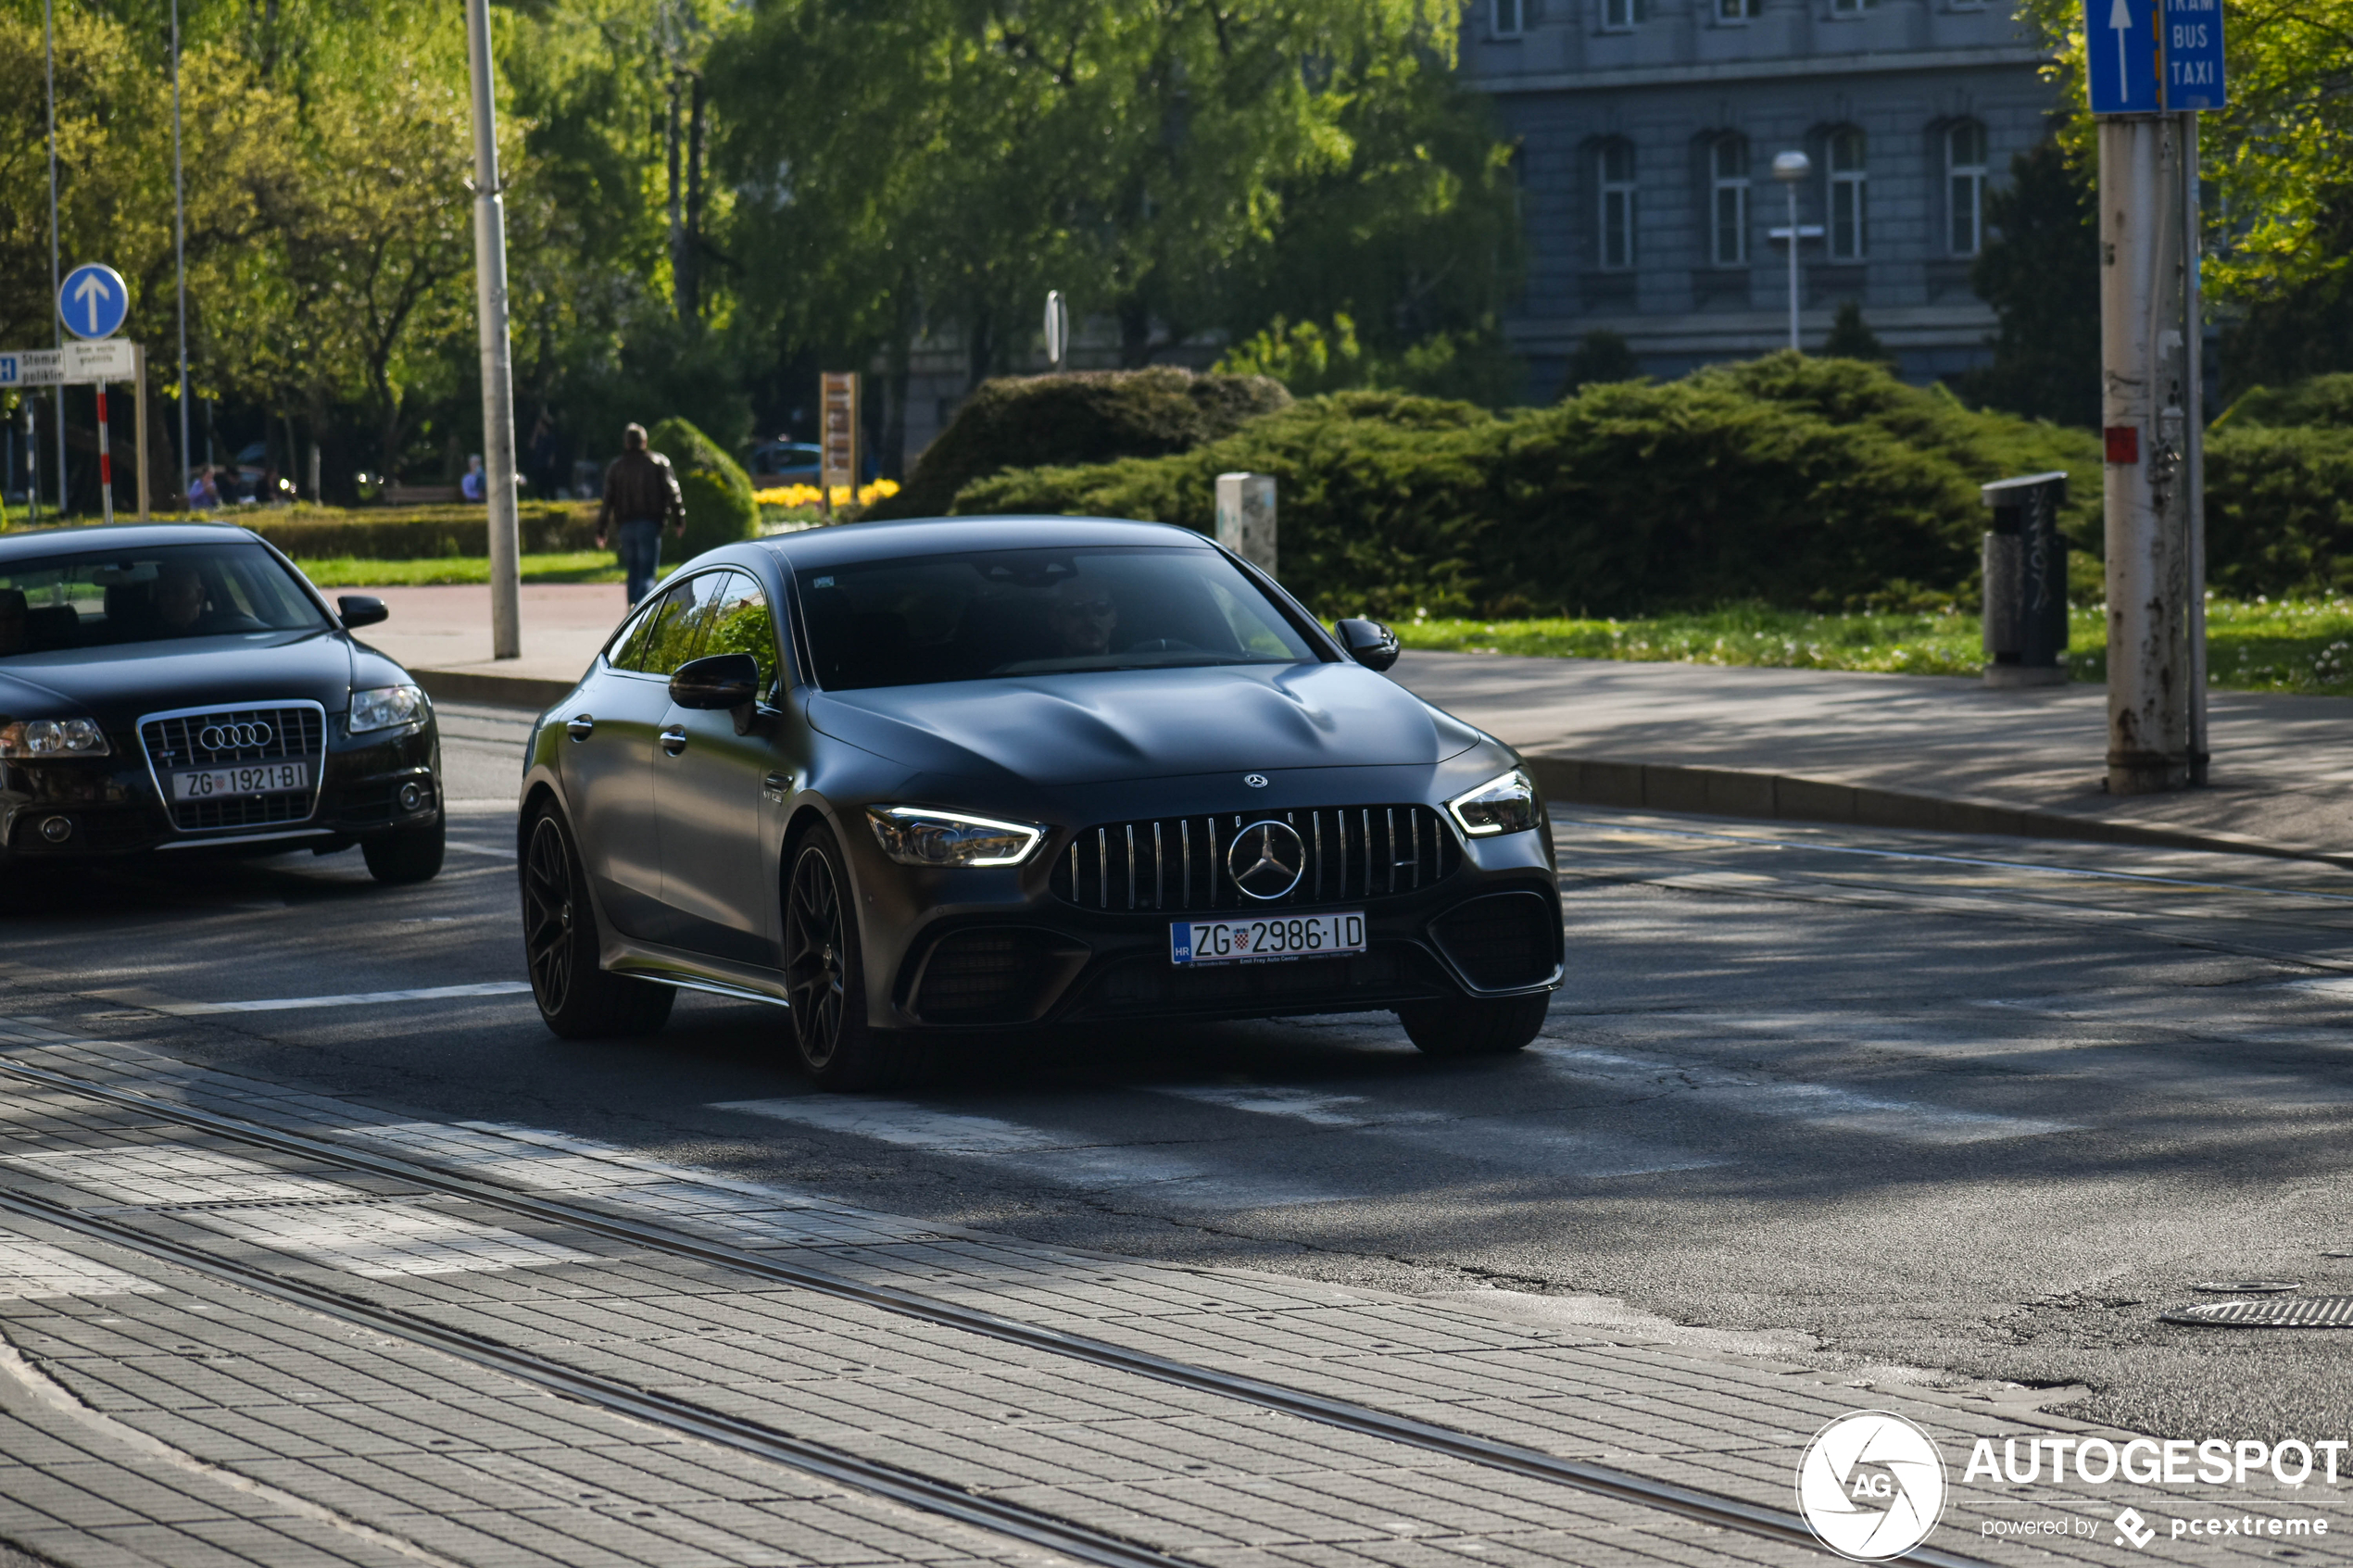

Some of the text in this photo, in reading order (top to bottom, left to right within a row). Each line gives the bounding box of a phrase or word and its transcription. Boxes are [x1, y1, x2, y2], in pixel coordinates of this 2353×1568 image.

[2172, 23, 2208, 48] BUS
[2171, 60, 2214, 85] TAXI
[186, 772, 213, 797] ZG
[1175, 947, 1190, 957] HR
[1194, 924, 1230, 957] ZG
